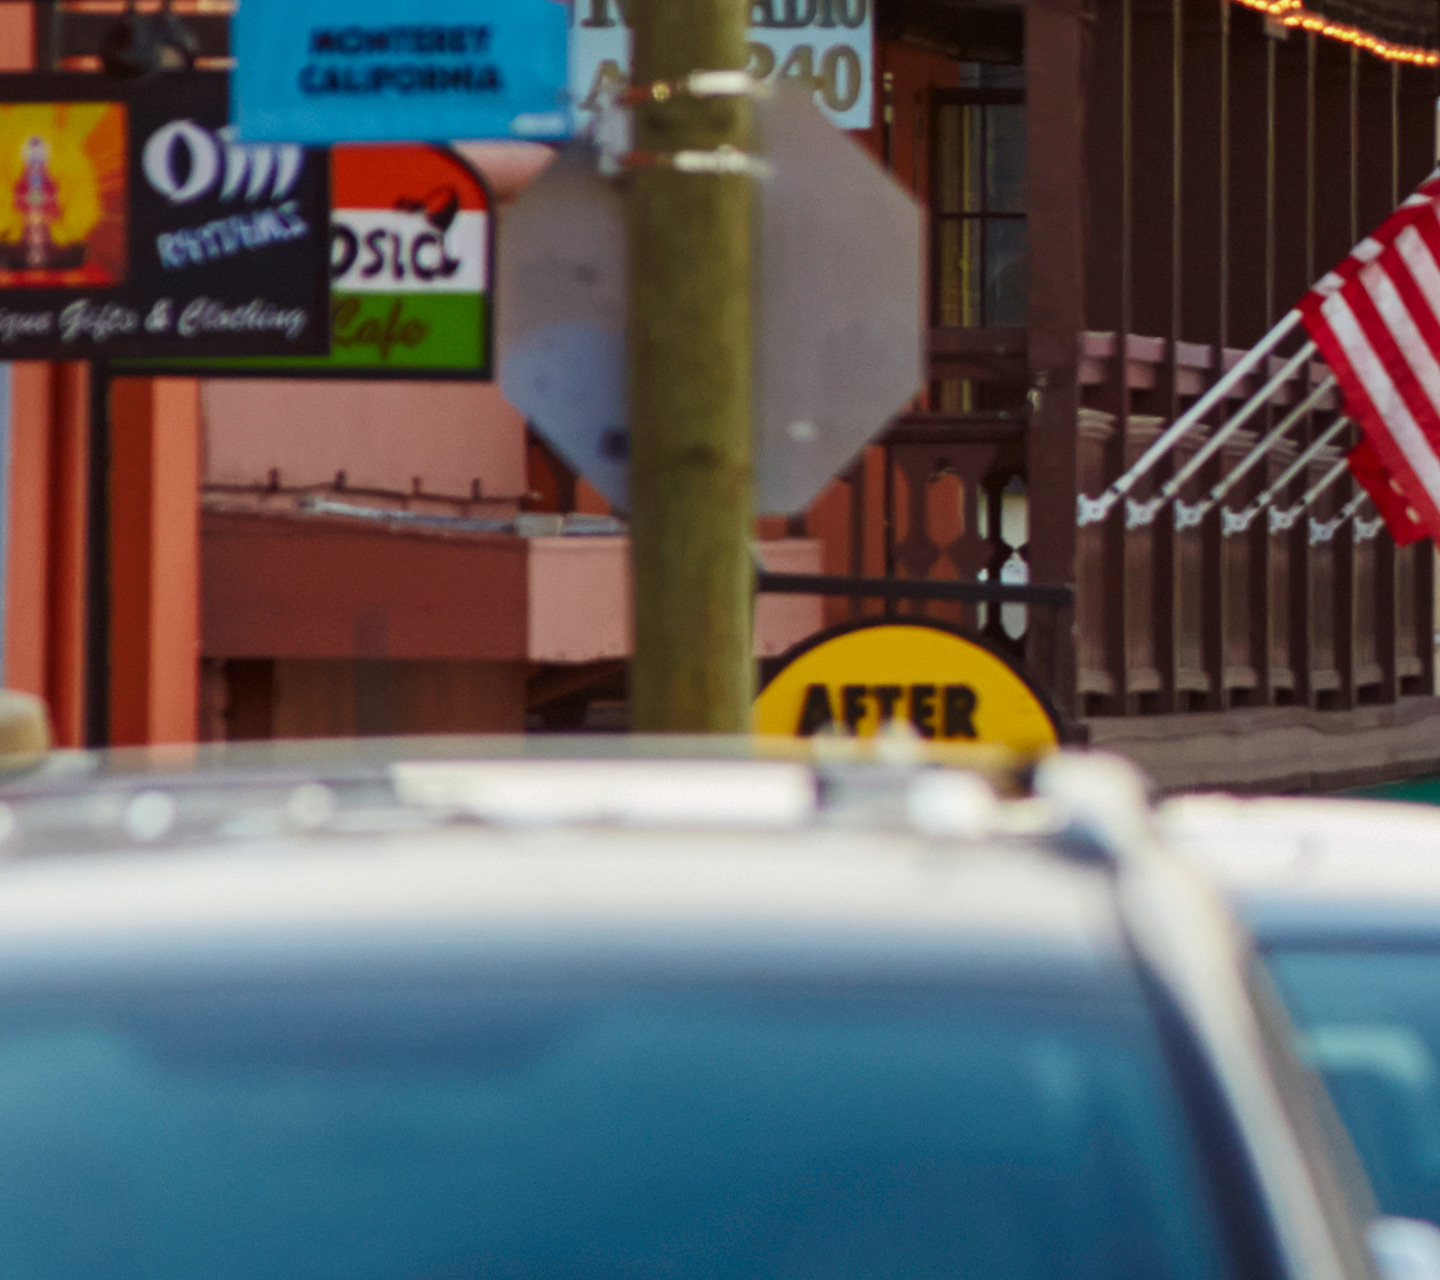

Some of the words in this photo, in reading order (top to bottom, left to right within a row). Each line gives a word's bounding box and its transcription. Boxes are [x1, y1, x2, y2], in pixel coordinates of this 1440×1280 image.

[309, 25, 491, 55] MONTEREY
[299, 64, 503, 96] CALIFORNIA
[745, 41, 862, 112] 240
[144, 295, 173, 334] &
[795, 683, 978, 741] AFTER
